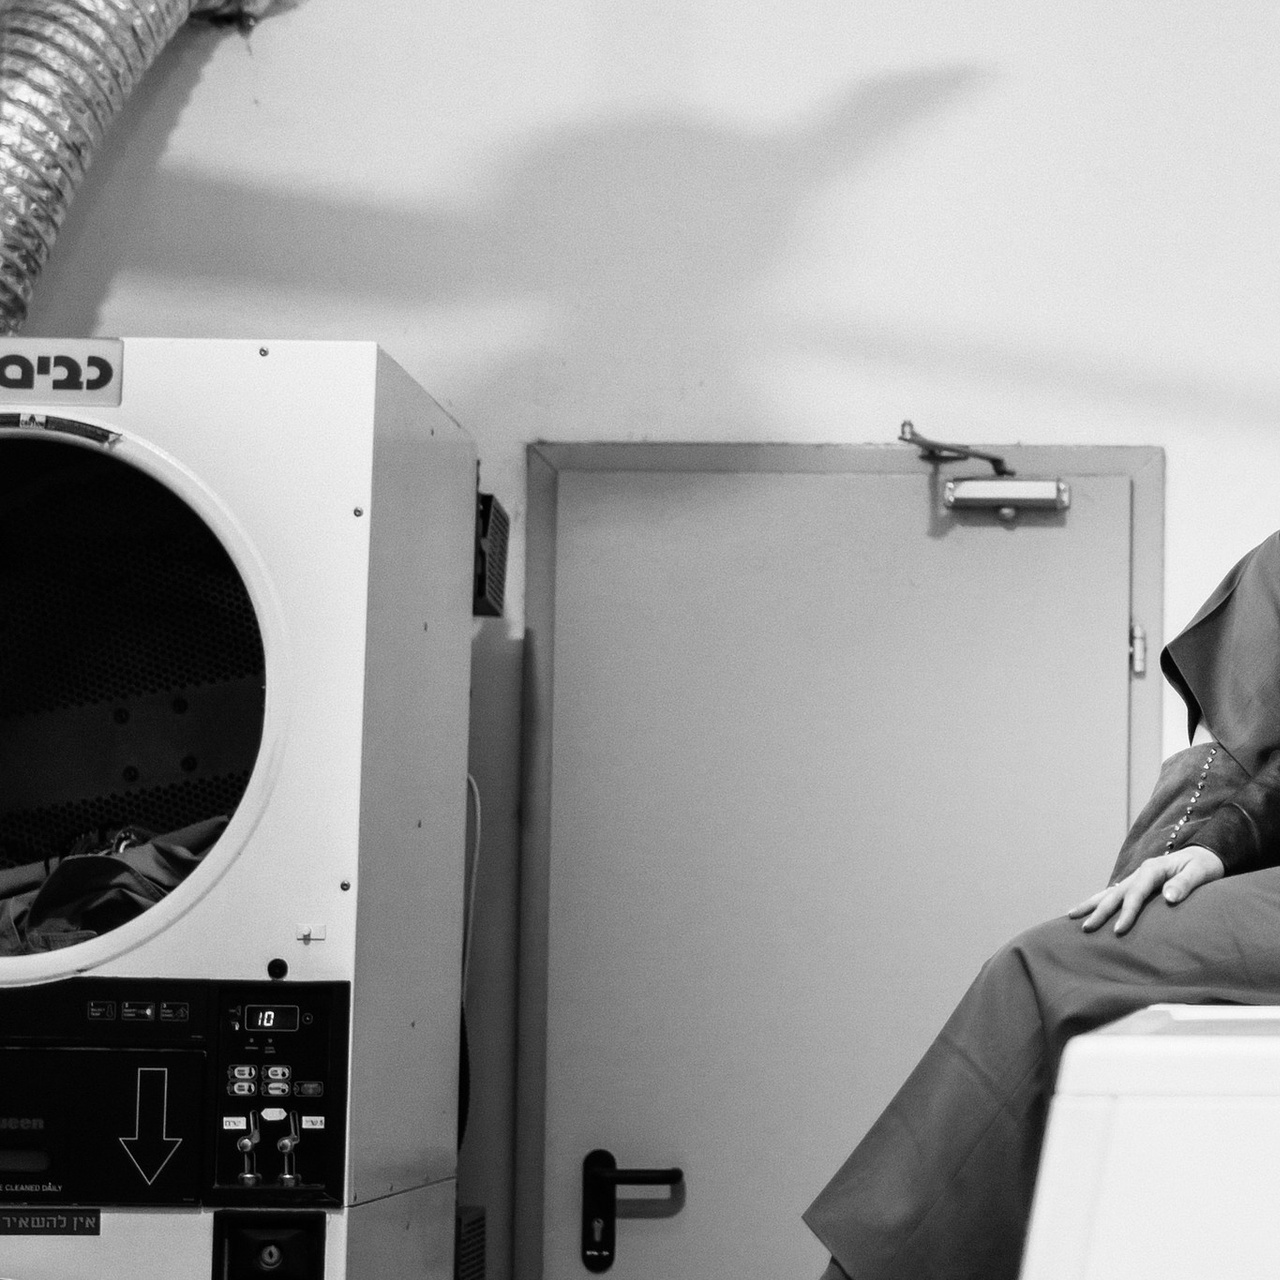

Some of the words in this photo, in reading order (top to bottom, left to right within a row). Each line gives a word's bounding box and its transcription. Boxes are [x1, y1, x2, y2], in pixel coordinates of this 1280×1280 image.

[258, 1011, 275, 1026] 10
[5, 1183, 41, 1192] CLEANED
[42, 1182, 63, 1192] DAILY
[2, 1214, 67, 1228] להשאיר
[72, 1216, 96, 1231] אין
